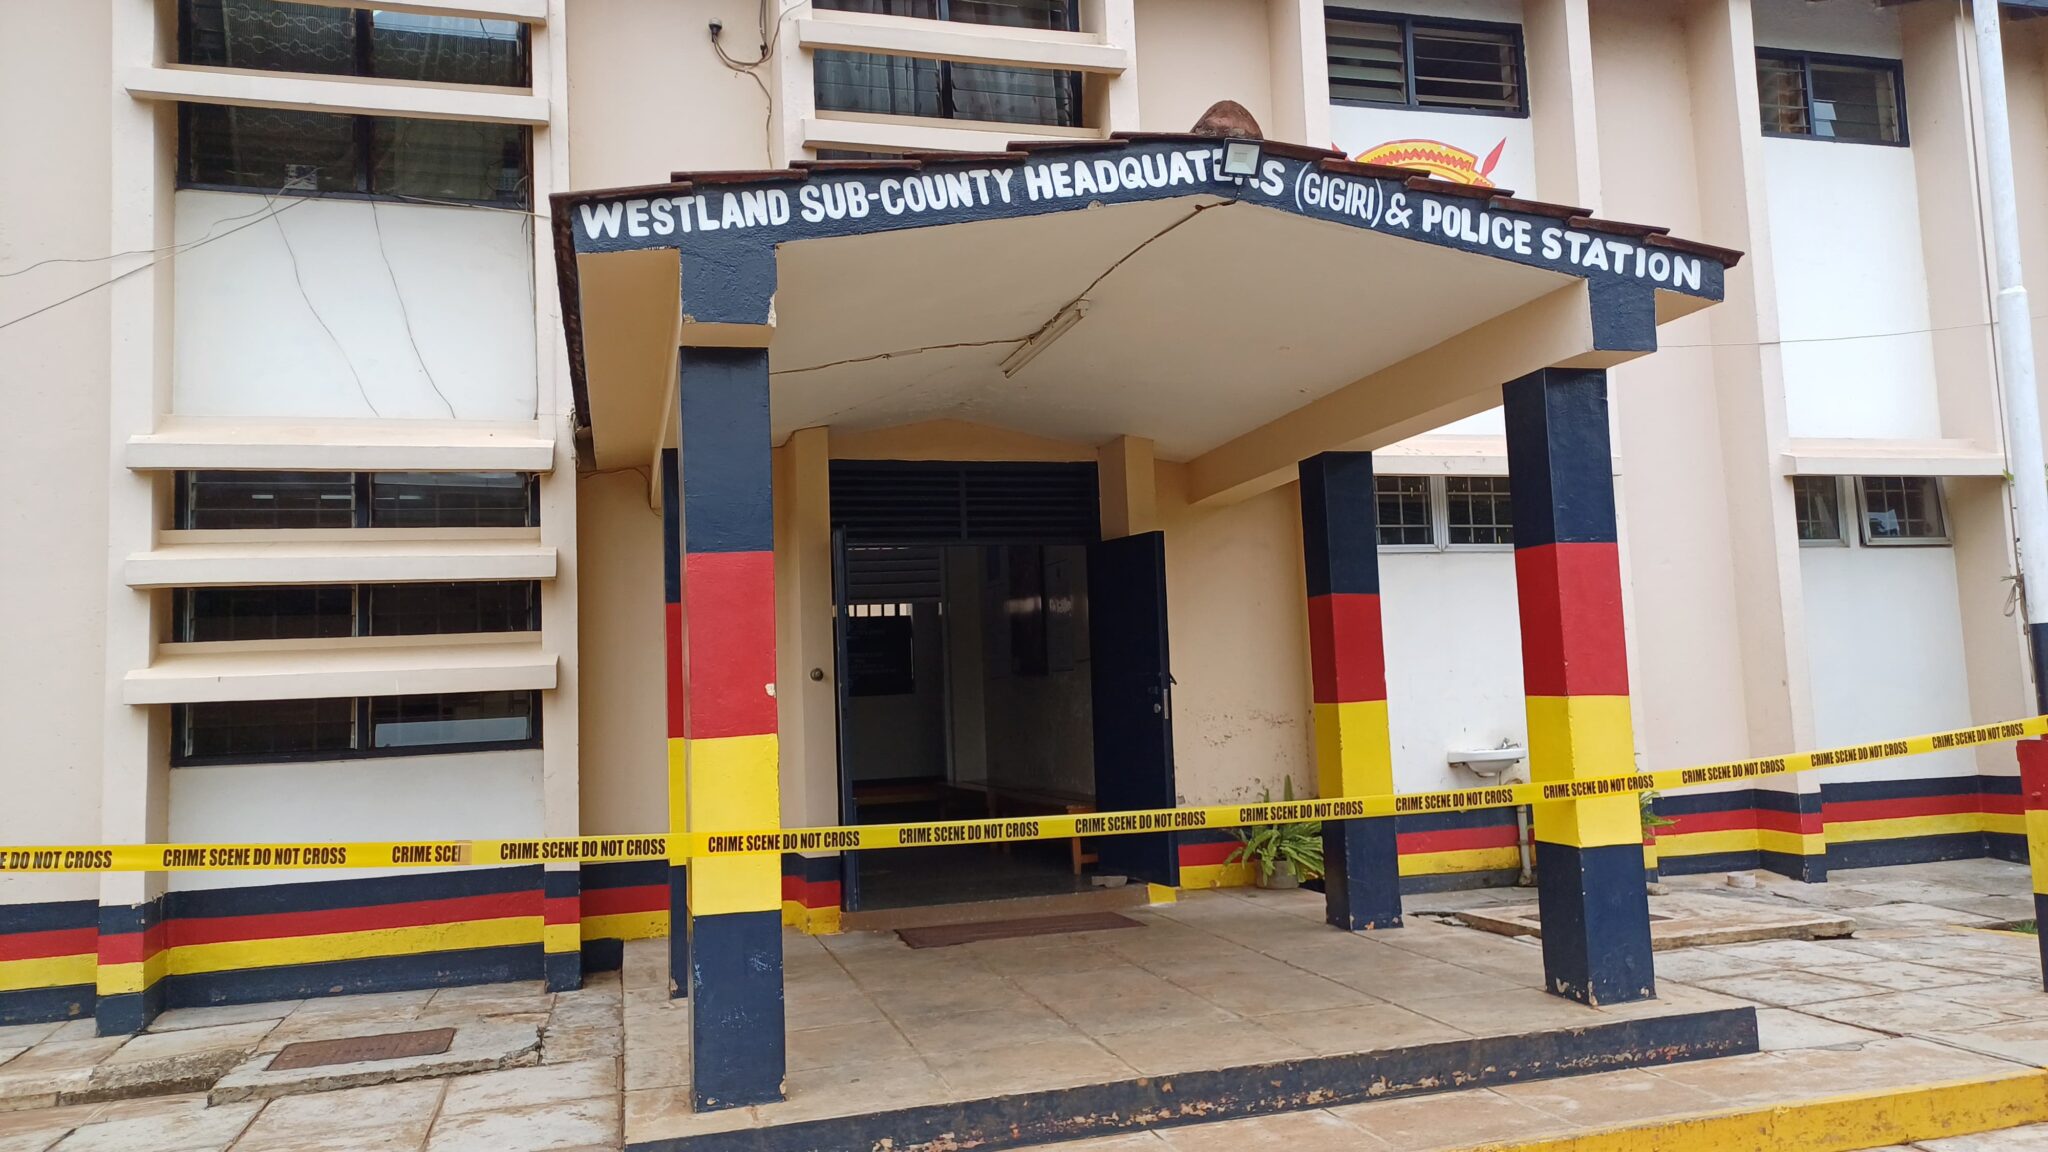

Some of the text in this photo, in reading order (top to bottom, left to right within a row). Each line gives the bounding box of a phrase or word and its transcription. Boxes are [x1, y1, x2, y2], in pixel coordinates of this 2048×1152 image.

[578, 189, 790, 240] WESTLAND
[800, 168, 1013, 223] SUB-COUNTY
[1024, 149, 1285, 200] HEADQUATES
[1422, 198, 1532, 256] POLICE
[1541, 226, 1701, 290] STATION
[1931, 723, 2024, 749] CRIME SCENE DO NOT CROSS
[1810, 741, 1908, 767] CRIME SCENE DO NOT CROSS
[1682, 758, 1786, 784] CRIME SCENE DO NOT CROSS
[1543, 774, 1654, 799] CRIME SCENE DO NOT CROSS
[1240, 801, 1363, 822] CRIME SCENE DO NOT CROSS
[1395, 788, 1513, 812] CRIME SCENE DO NOT CROSS
[899, 821, 1039, 844] CRIME SCENE DO NOT CROSS
[1075, 810, 1206, 834] CRIME SCENE DO NOT CROSS
[500, 838, 666, 860] CRIME SCENE DO NOT CROSS
[708, 830, 860, 853] CRIME SCENE DO NOT CROSS
[9, 851, 30, 869] DO
[32, 851, 62, 869] NOT
[64, 850, 113, 869] CROSS
[163, 847, 346, 867] CRIME SCENE DO NOT CROSS
[392, 845, 461, 863] CRIME SCE
